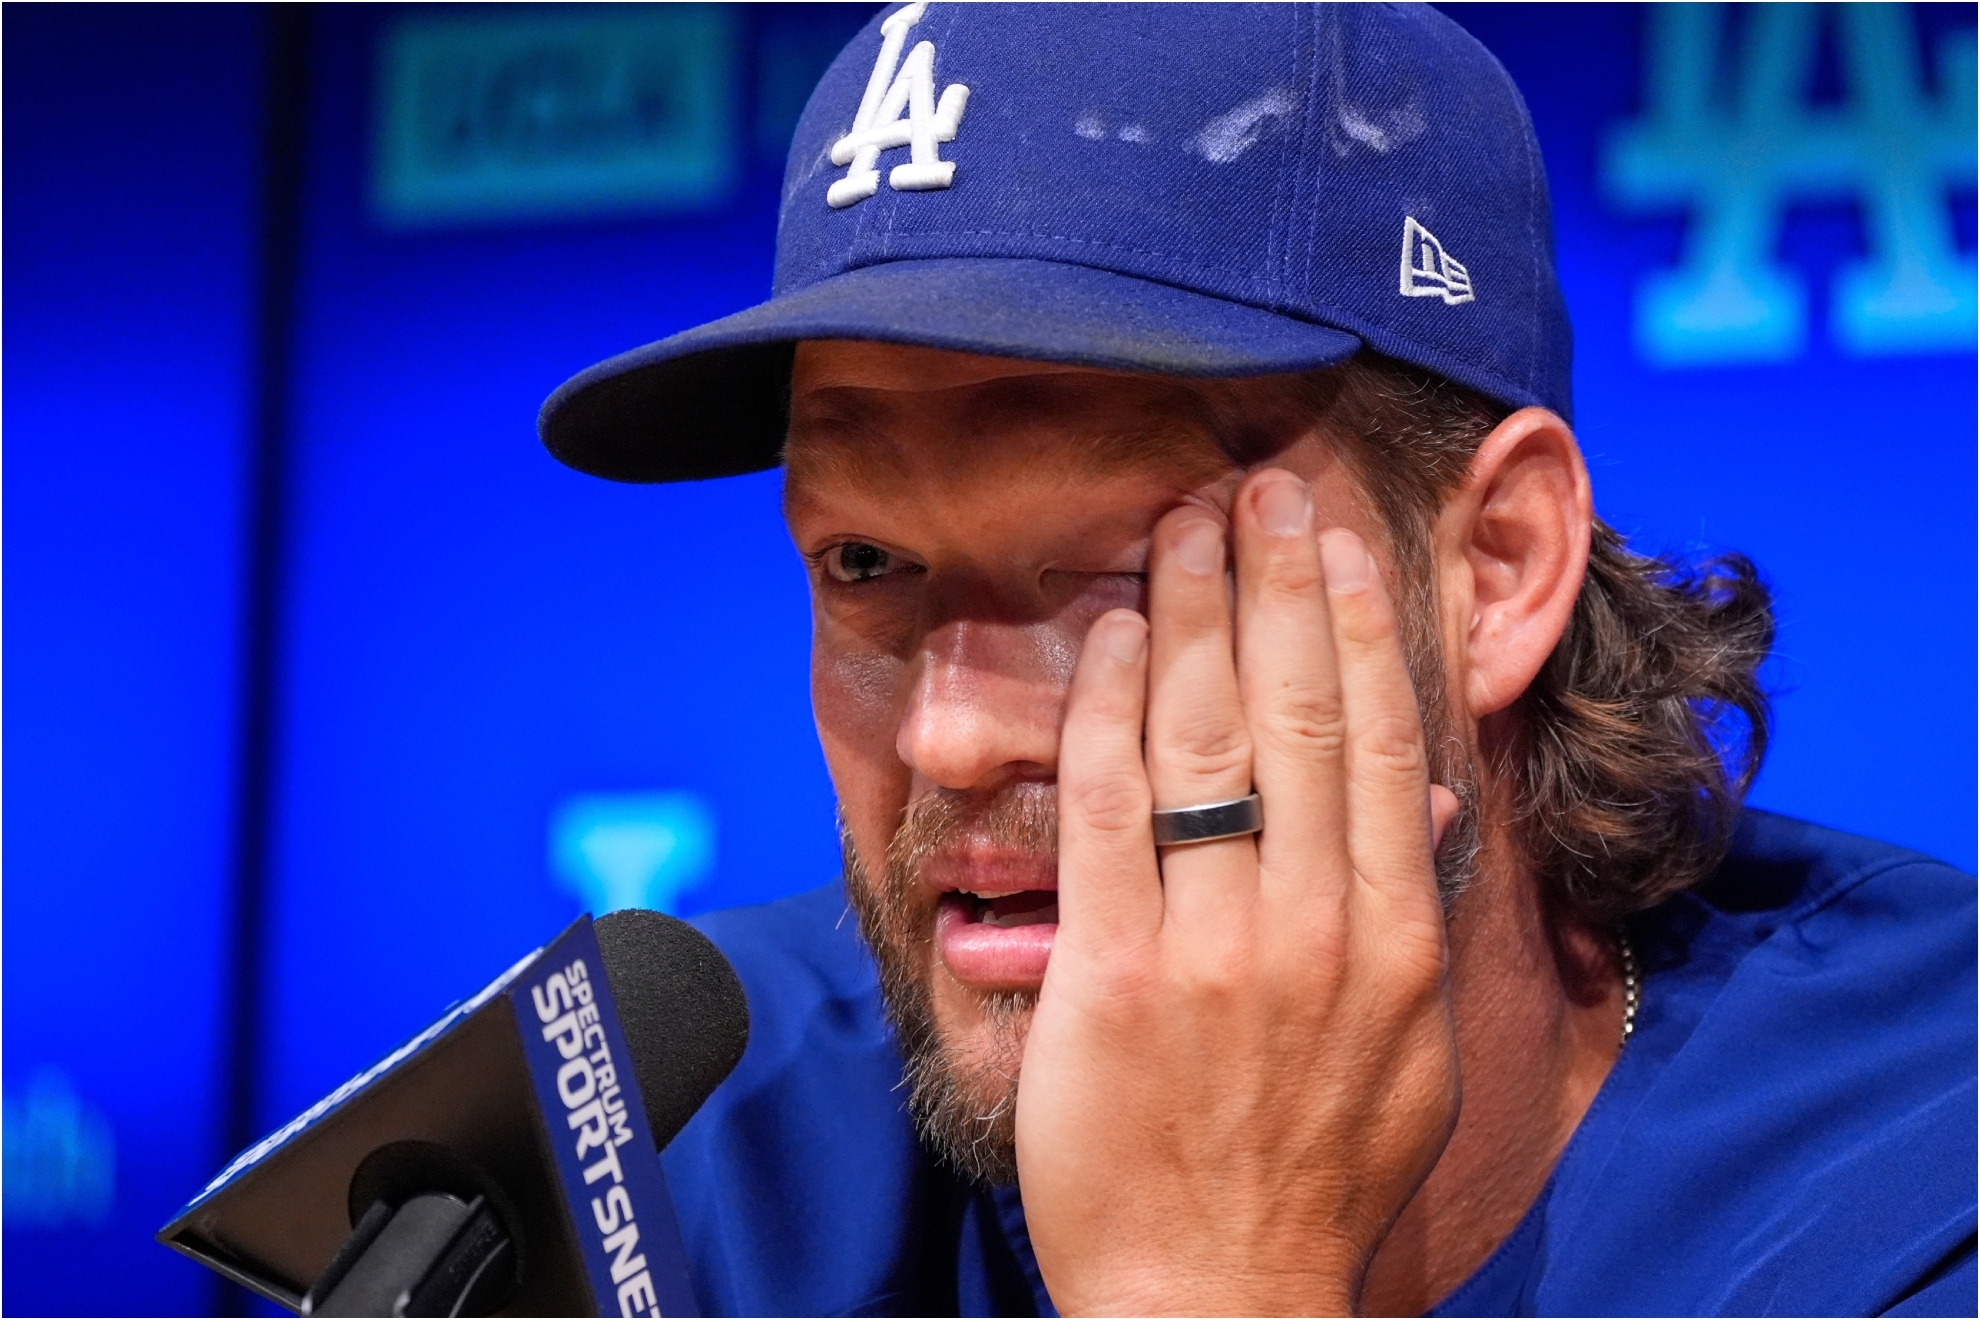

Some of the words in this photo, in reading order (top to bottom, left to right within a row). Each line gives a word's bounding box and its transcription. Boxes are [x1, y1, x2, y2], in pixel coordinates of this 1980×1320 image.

[827, 2, 969, 209] LA
[531, 972, 662, 1318] SPORTSNE
[564, 959, 634, 1148] SPECTRUM
